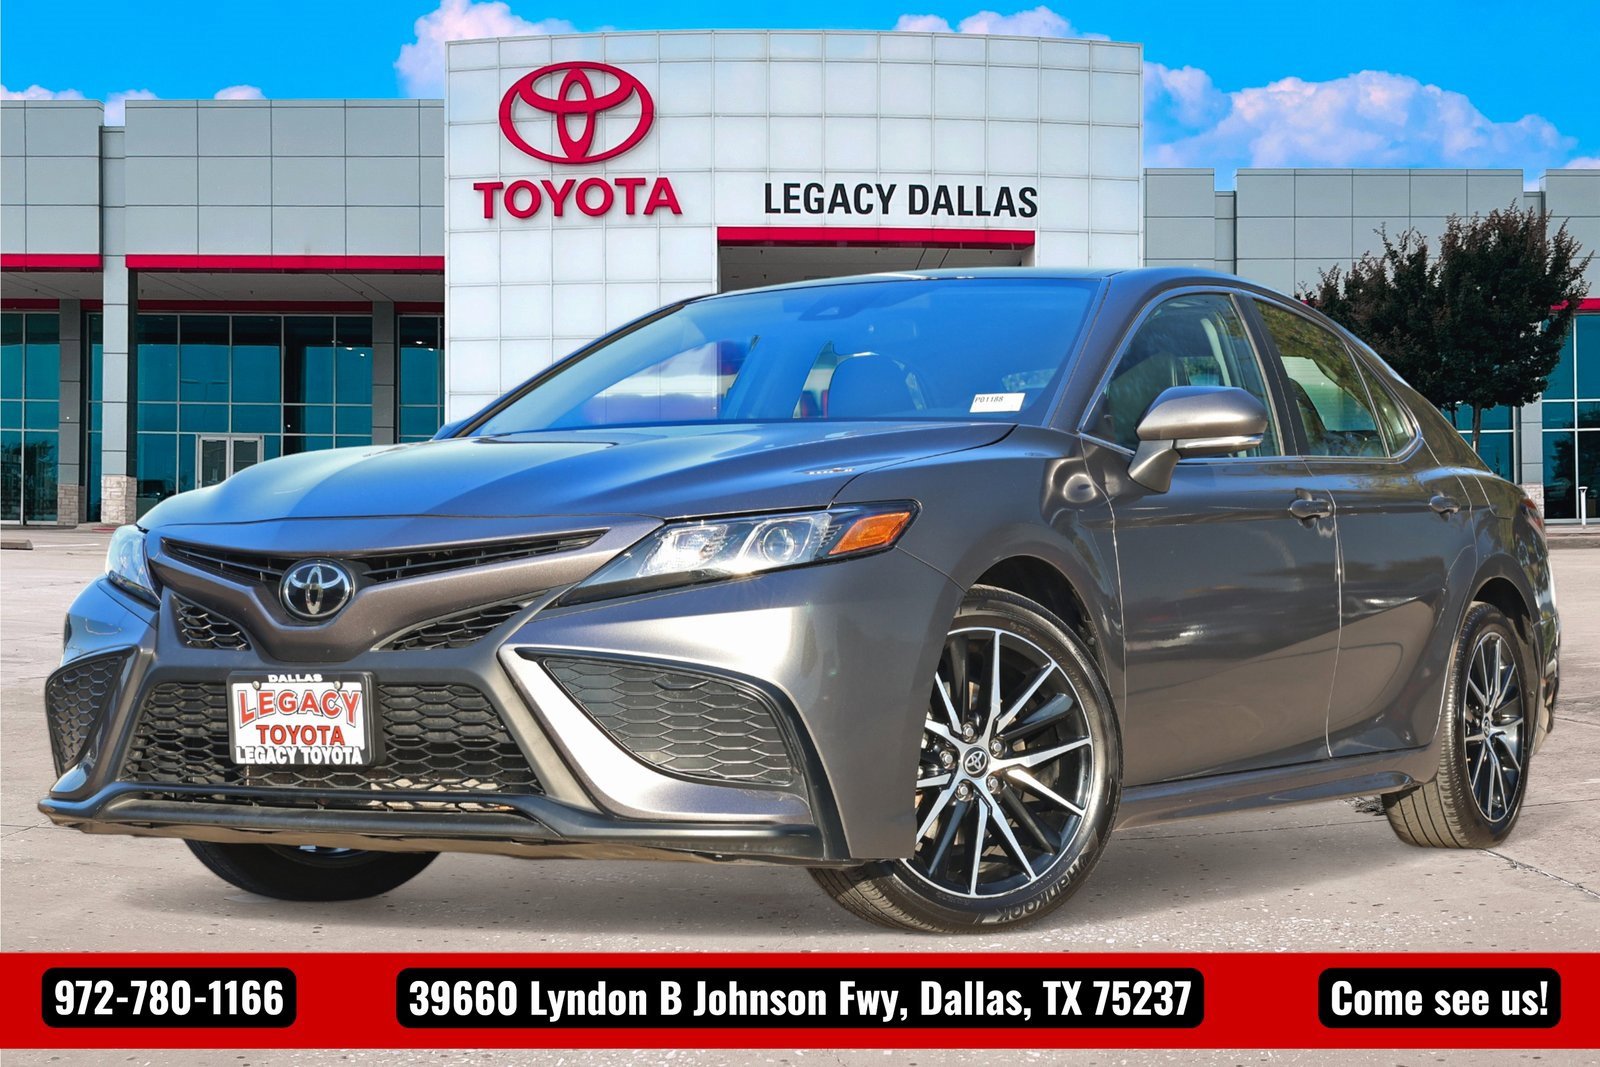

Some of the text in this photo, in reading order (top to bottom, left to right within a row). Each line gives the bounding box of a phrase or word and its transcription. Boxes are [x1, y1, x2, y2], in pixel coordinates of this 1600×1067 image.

[473, 177, 683, 219] TOYOTA
[764, 182, 1038, 218] LEGACY DALLAS
[268, 673, 323, 683] DALLAS
[238, 690, 362, 728] LEGACY
[256, 724, 346, 746] TOYOTA
[235, 746, 363, 765] LEGACY TOYOTA
